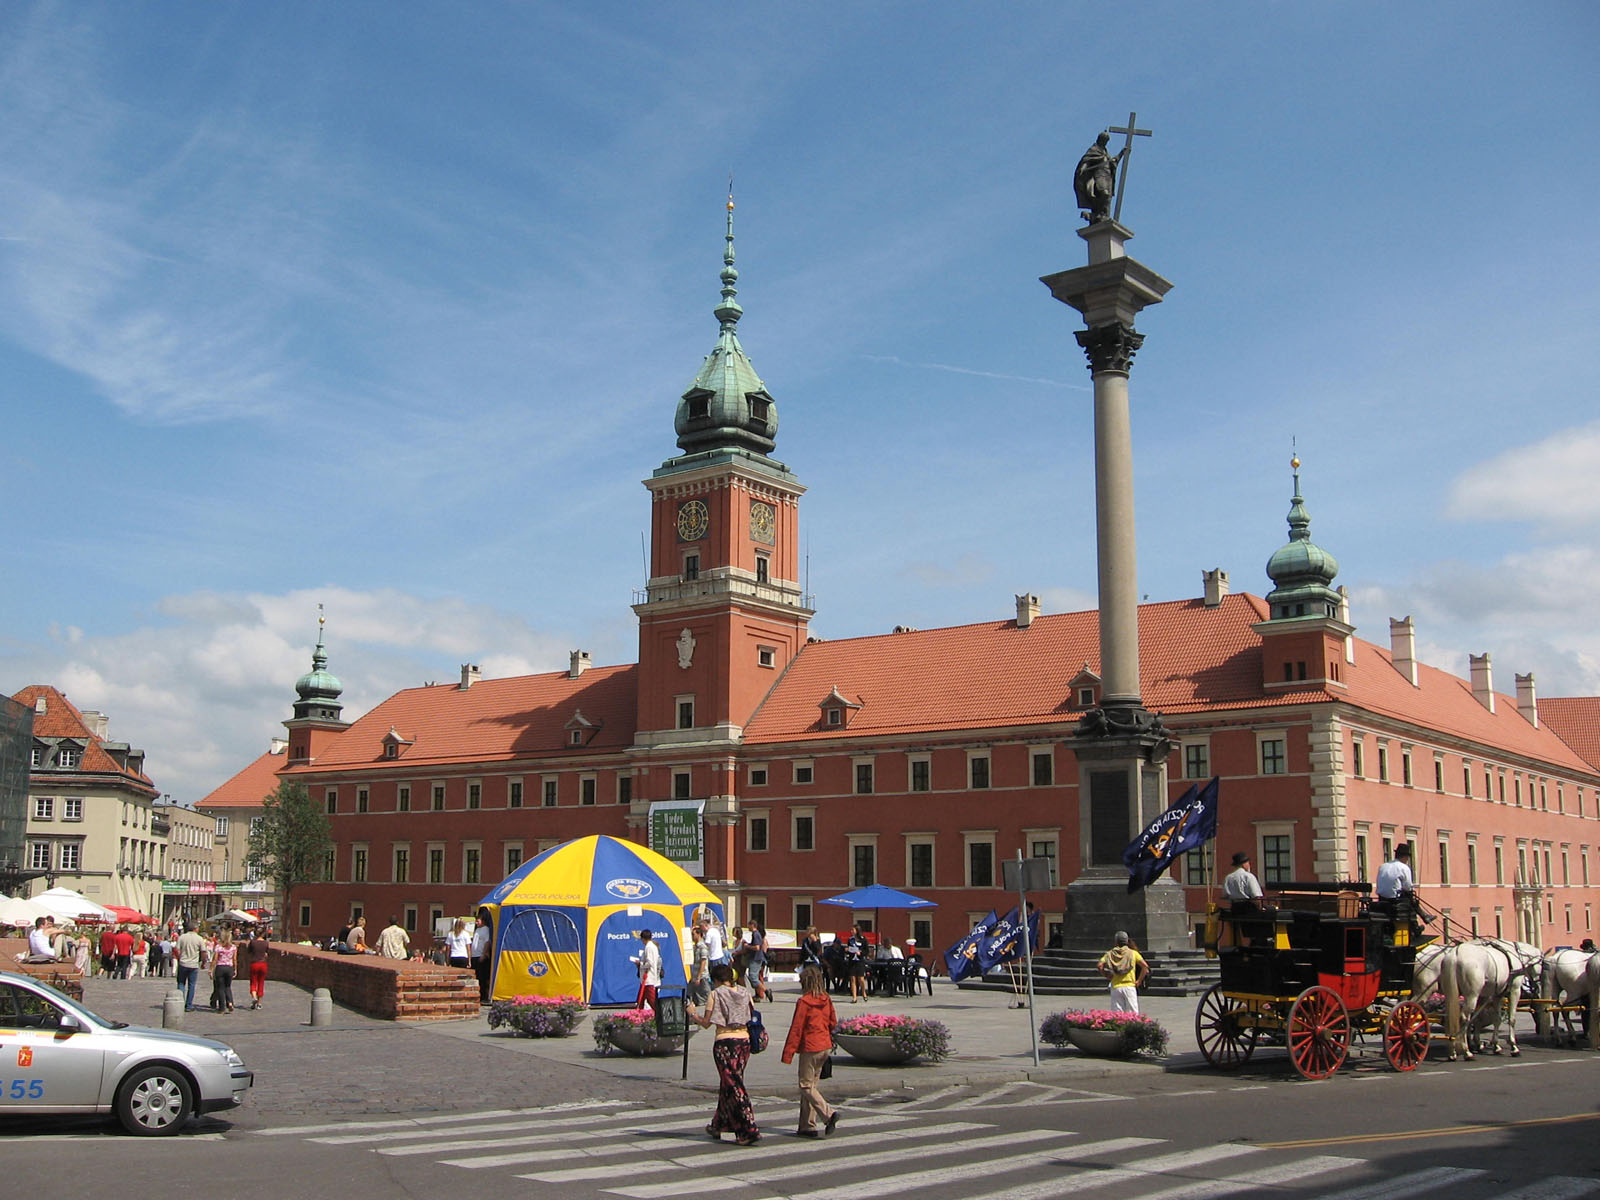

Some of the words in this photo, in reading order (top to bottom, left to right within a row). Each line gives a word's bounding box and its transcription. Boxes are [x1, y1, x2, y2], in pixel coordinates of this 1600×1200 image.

[669, 823, 696, 838] Ogrodach
[665, 835, 697, 849] Muzycznych
[665, 847, 692, 860] Warszawy
[651, 931, 669, 939] olska
[9, 1079, 44, 1099] 55
